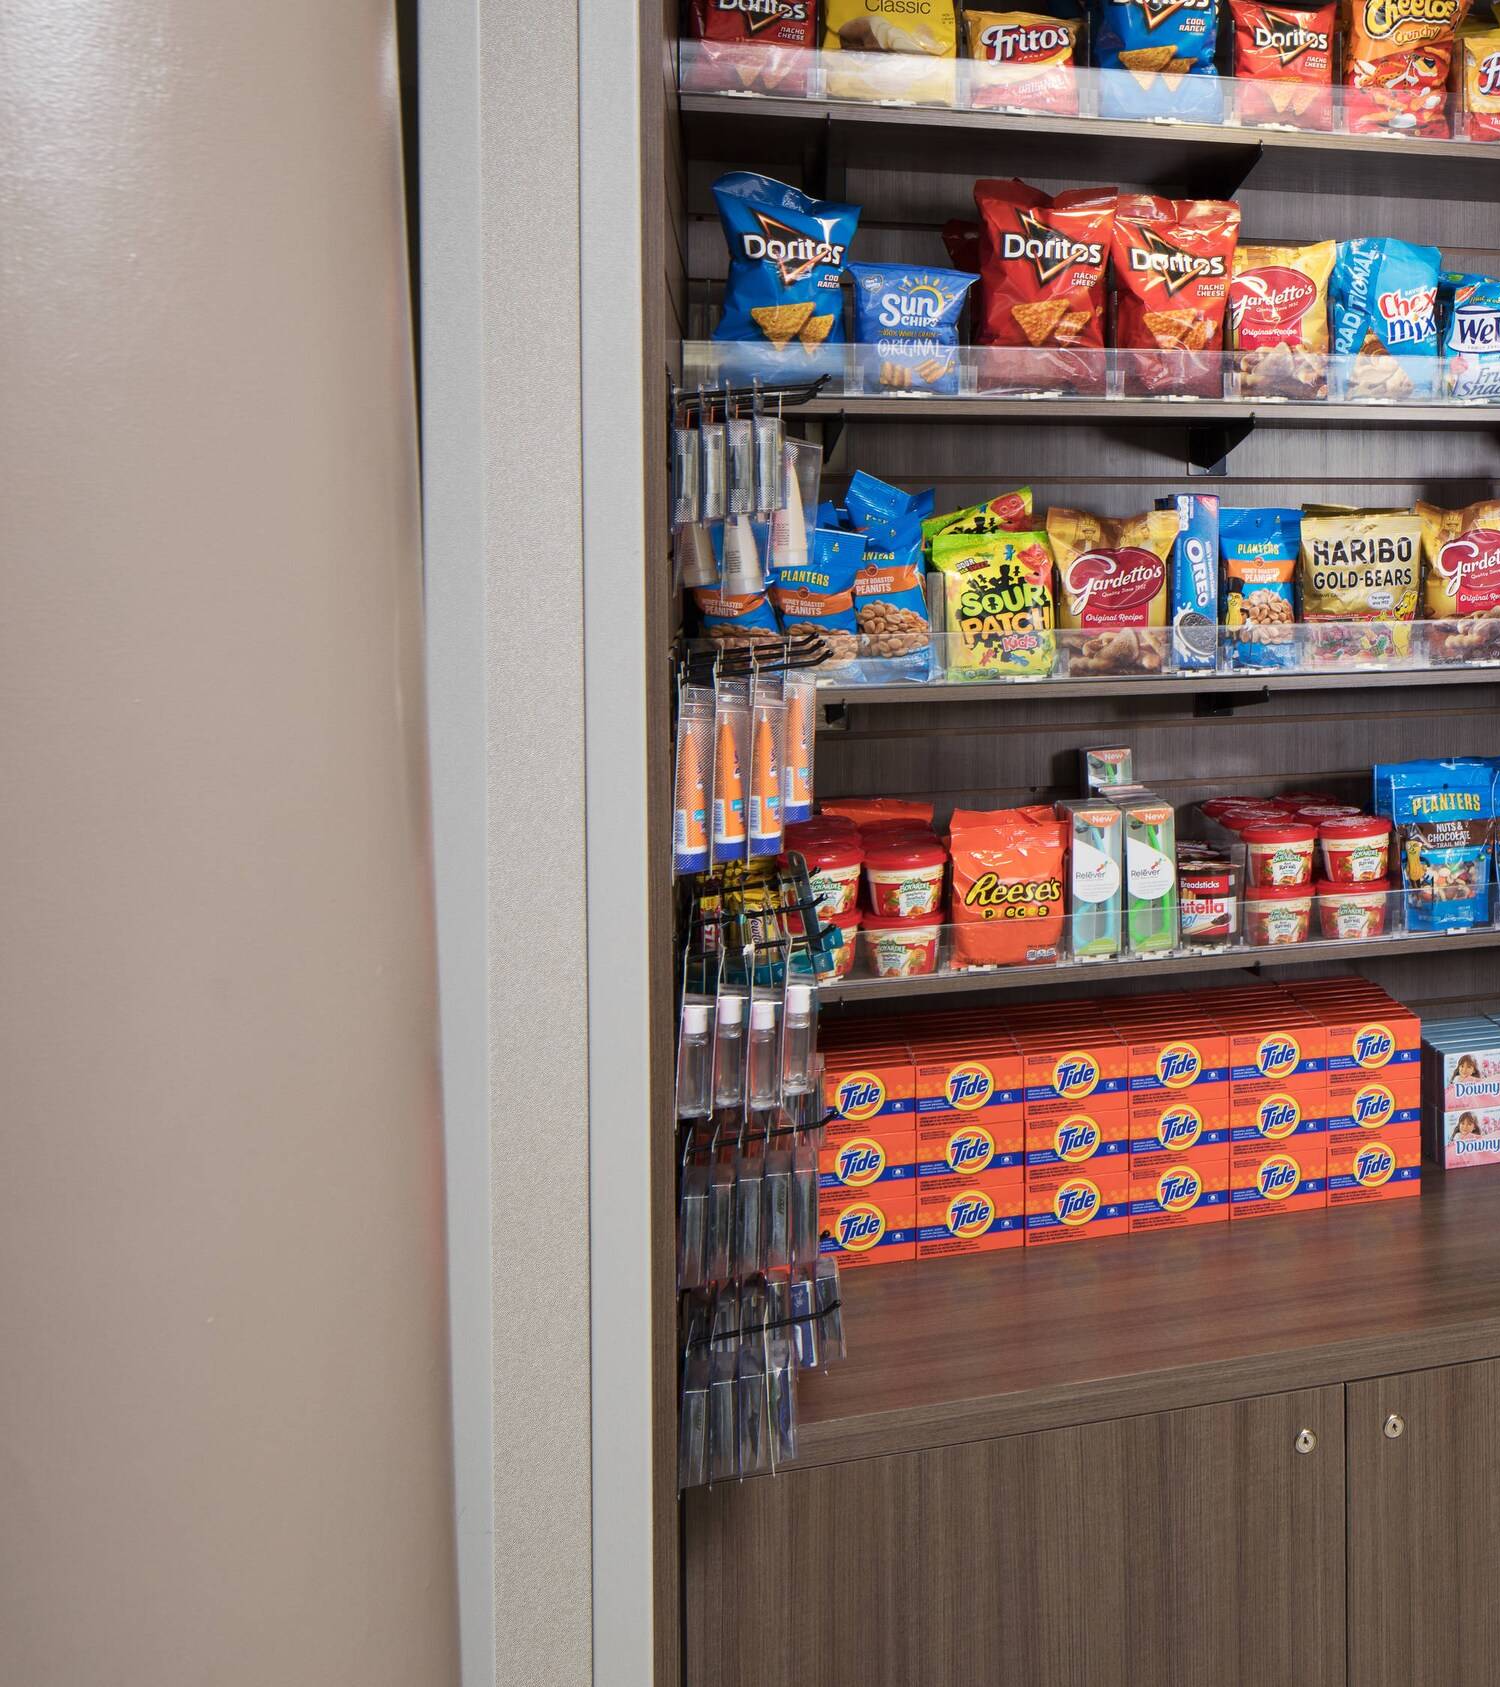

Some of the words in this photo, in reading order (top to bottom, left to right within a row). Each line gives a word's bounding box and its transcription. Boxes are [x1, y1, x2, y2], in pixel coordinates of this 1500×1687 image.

[864, 0, 931, 14] Classic
[780, 27, 805, 35] NACHO
[1178, 24, 1206, 33] RANCH
[1185, 18, 1206, 26] COOL
[1394, 24, 1440, 45] Crunchy
[777, 32, 806, 41] CHEESE
[980, 23, 1070, 66] Fritos
[1255, 28, 1328, 50] Doritos
[1304, 61, 1328, 70] CHEESE
[1306, 56, 1328, 64] NACHO
[743, 234, 844, 265] Doritos
[1004, 233, 1102, 264] Doritos
[1131, 247, 1225, 275] Doritos
[824, 273, 839, 282] COO
[1073, 272, 1098, 281] NACHO
[1197, 283, 1225, 291] NACHO
[1196, 289, 1225, 298] CHEESE
[1232, 276, 1314, 328] Gardetto's
[1335, 249, 1376, 354] RADITIONAL
[1378, 288, 1438, 319] Chex
[879, 293, 941, 327] Sun
[901, 315, 939, 328] CHIPS
[1388, 312, 1438, 343] mix
[877, 339, 946, 358] ORIGINAL
[1237, 543, 1280, 555] PLANTERS
[1313, 536, 1412, 567] HARIBO
[780, 569, 830, 587] PLANTERS
[1065, 554, 1162, 616] Gardetto's
[1185, 537, 1208, 608] OREO
[1313, 567, 1412, 591] GOLD-BEARS
[856, 584, 892, 594] PEANUTS
[961, 584, 1047, 617] SOUR
[1459, 591, 1489, 604] Original
[785, 605, 822, 616] PEANUTS
[1085, 613, 1117, 625] Original
[1118, 612, 1145, 624] Recipe
[961, 607, 1051, 646] PATCH
[1002, 633, 1038, 652] Kids
[1104, 752, 1123, 761] New
[1144, 812, 1166, 822] New
[1411, 793, 1481, 816] PLANTERS
[1091, 815, 1113, 824] New
[1436, 823, 1456, 832] NUTS
[1457, 822, 1463, 831] &
[1427, 831, 1471, 843] CHOCOLATE
[1180, 880, 1220, 889] Breadsticks
[1260, 1045, 1296, 1071] Tide
[1357, 1035, 1391, 1062] Tide
[1056, 1063, 1095, 1092] Tide
[1160, 1055, 1198, 1081] Tide
[840, 1085, 881, 1113] Tide
[950, 1074, 989, 1102] Tide
[1455, 1080, 1500, 1098] Downy
[1260, 1105, 1296, 1132] Tide
[1356, 1095, 1391, 1122] Tide
[1058, 1127, 1096, 1155] Tide
[1161, 1116, 1198, 1143] Tide
[951, 1138, 990, 1166] Tide
[1456, 1137, 1500, 1155] Downy
[840, 1150, 881, 1179] Tide
[1357, 1154, 1392, 1180] Tide
[1160, 1179, 1198, 1205] Tide
[1260, 1166, 1296, 1193] Tide
[951, 1203, 990, 1231] Tide
[1058, 1190, 1096, 1219] Tide
[840, 1215, 881, 1244] Tide
